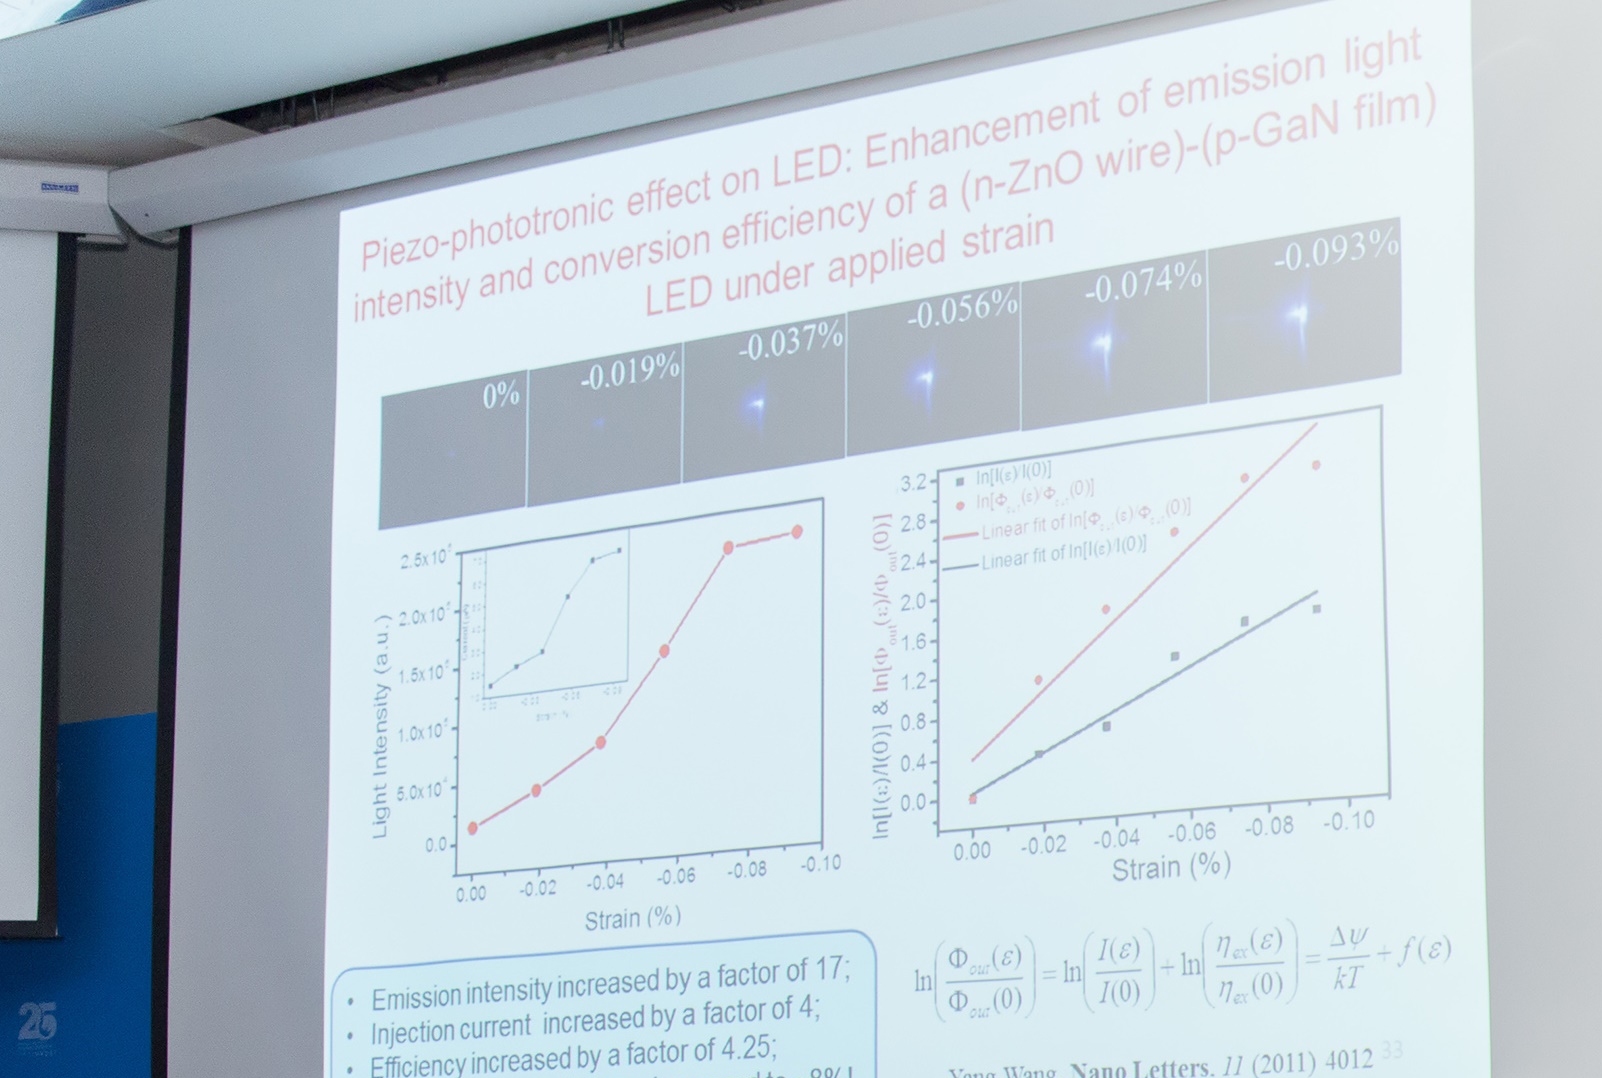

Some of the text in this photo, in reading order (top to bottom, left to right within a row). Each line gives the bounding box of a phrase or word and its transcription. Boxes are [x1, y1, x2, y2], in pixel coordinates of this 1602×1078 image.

[361, 27, 1422, 273] Piezo-phototronic effect on LED: Enhancement of emission light
[353, 81, 1437, 324] intensity and conversion efficiency of a (n-ZnO wire)-(p-GaN film)
[645, 212, 1055, 318] LED under applied strain
[1274, 226, 1399, 271] -0.093%
[1085, 259, 1201, 303] -0.074%
[908, 288, 1019, 331] -0.056%
[738, 319, 843, 360] -0.037%
[580, 350, 679, 390] -0.019%
[483, 378, 520, 409] 0%
[900, 471, 927, 493] 3.2
[900, 512, 927, 534] 2.8
[900, 551, 927, 573] 2.4
[900, 591, 927, 613] 2.0
[901, 631, 927, 652] 1.6
[901, 670, 927, 691] 1.2
[371, 614, 393, 840] Light Intensity (a.u.)
[899, 711, 927, 733] 0.8
[899, 752, 927, 773] 0.4
[899, 791, 927, 813] 0.0
[424, 835, 448, 854] 0.0
[952, 808, 1376, 862] 0.00 -0.02 -0.04 -0.06 -0.08 -0.10
[455, 852, 842, 904] 0.00 -0.02 -0.04 -0.06 -0.08 -0.10
[1111, 850, 1232, 883] Strain (%)
[584, 904, 683, 932] Strain (%)
[371, 953, 851, 1012] Emission intensity increased by a factor of 17;
[370, 993, 821, 1051] Injection current increased by a factor of 4;
[470, 1045, 572, 1075] increased
[576, 1044, 602, 1075] by
[606, 1047, 621, 1068] a
[625, 1040, 690, 1066] factor
[692, 1036, 717, 1063] of
[720, 1032, 777, 1062] 4.25;
[1222, 1054, 1244, 1077] 11
[1324, 1046, 1374, 1071] 4012
